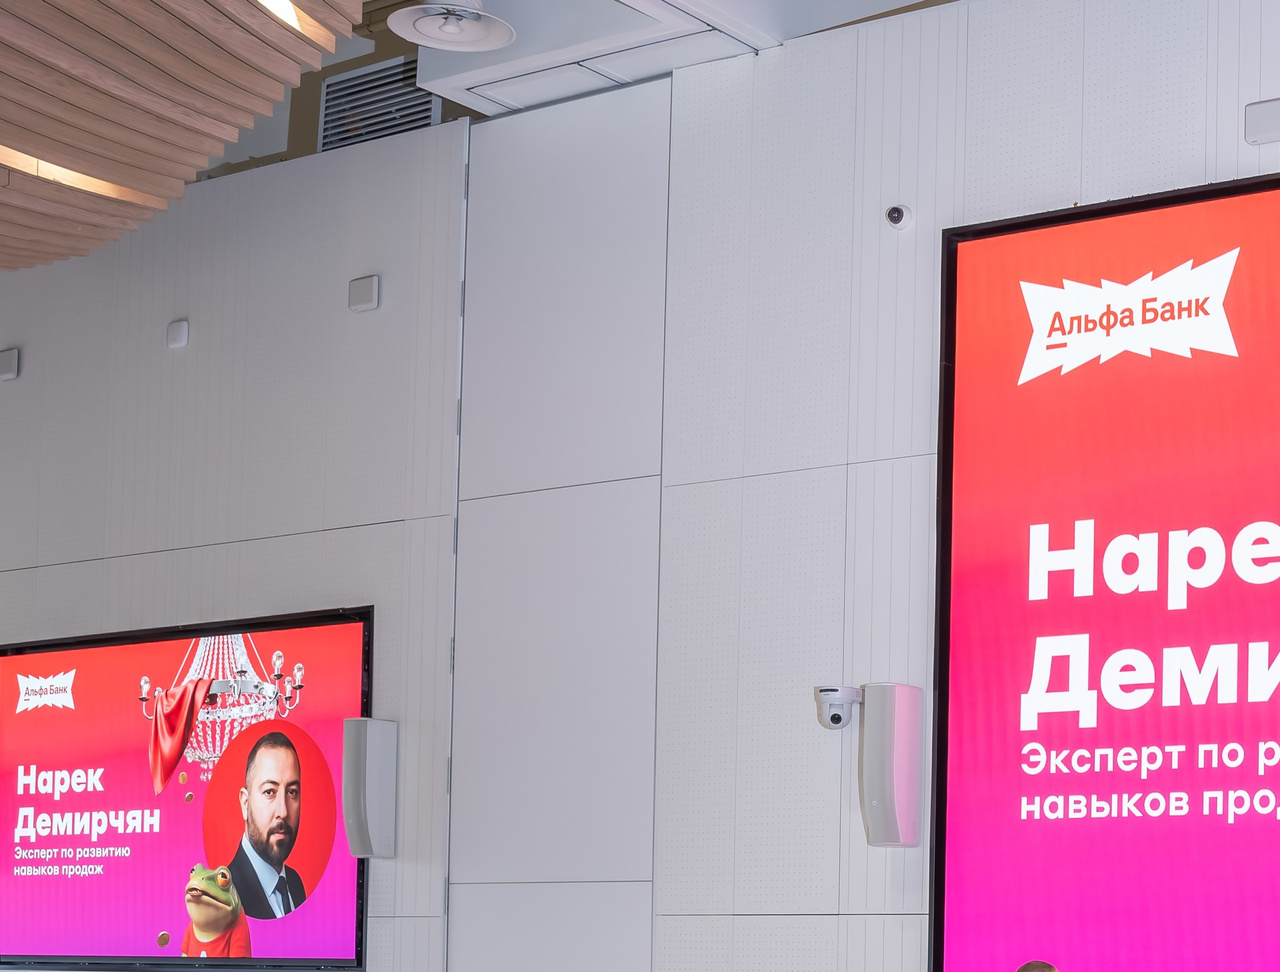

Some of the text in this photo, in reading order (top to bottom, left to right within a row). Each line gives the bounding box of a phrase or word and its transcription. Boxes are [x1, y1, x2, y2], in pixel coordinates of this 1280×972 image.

[1046, 296, 1211, 349] Альфа Банк
[24, 684, 68, 701] Альфа Банк
[1020, 742, 1186, 780] Эксперт
[1198, 743, 1245, 769] по
[17, 765, 104, 800] Нарек
[1020, 792, 1190, 820] навыков
[14, 807, 160, 842] Демирчян
[14, 844, 131, 861] Эксперт по развитию
[14, 862, 104, 877] навыков продаж
